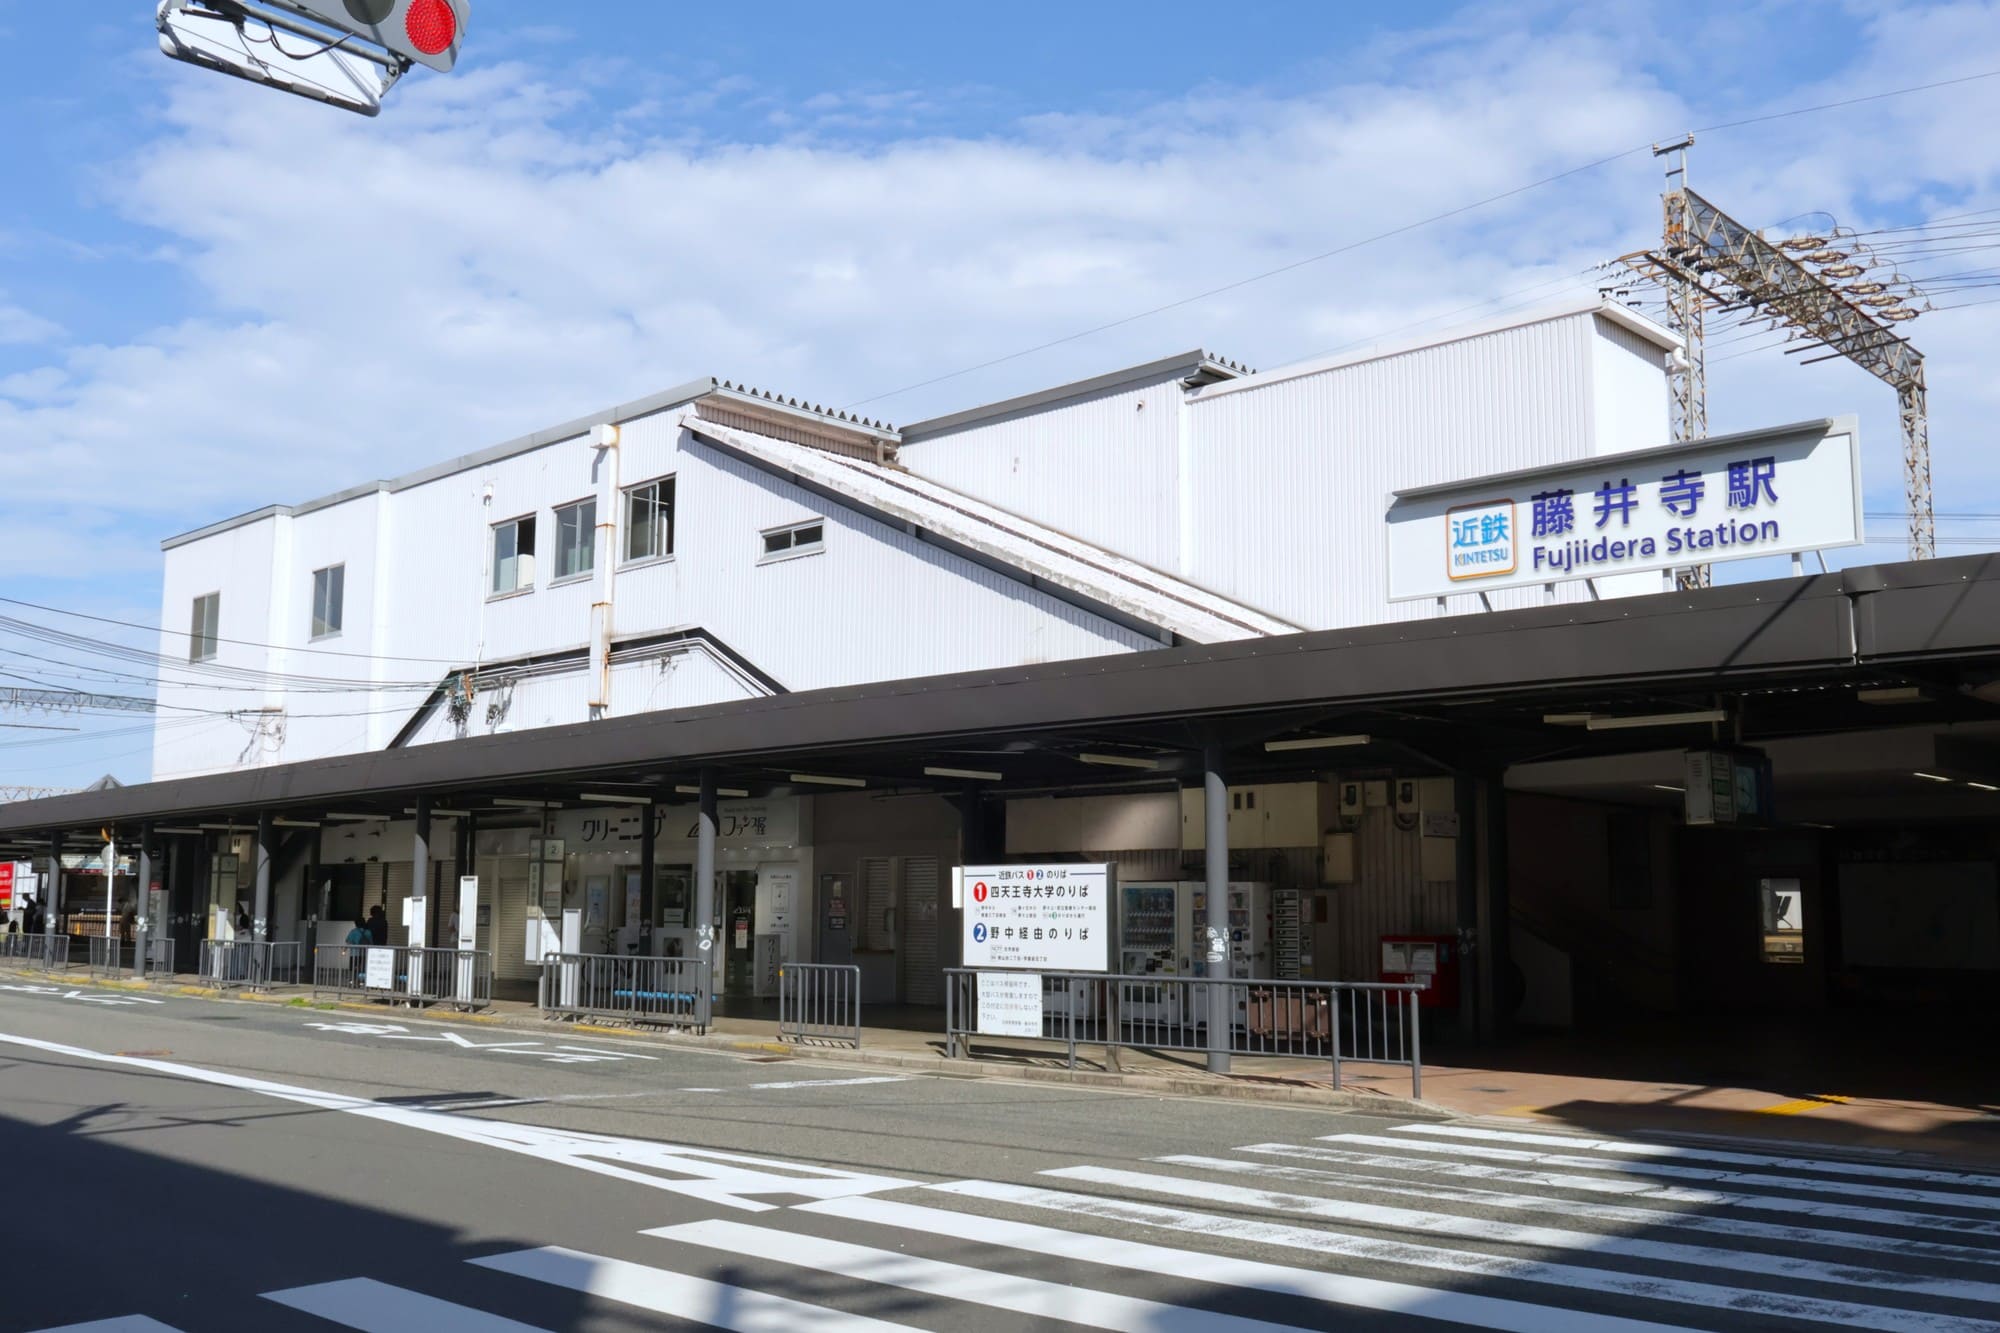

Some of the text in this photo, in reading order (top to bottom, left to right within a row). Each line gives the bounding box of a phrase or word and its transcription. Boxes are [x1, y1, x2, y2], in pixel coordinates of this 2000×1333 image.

[1530, 456, 1779, 538] 藤井寺駅
[1452, 512, 1509, 549] 近鉄
[1532, 517, 1780, 573] Fujiidera Station
[1454, 548, 1509, 567] KINTETSU
[998, 870, 1025, 880] 近鉄バス
[1046, 870, 1067, 879] のりば
[990, 884, 1089, 899] 四天王寺大学のりば
[990, 926, 1089, 941] 野中経由のりば
